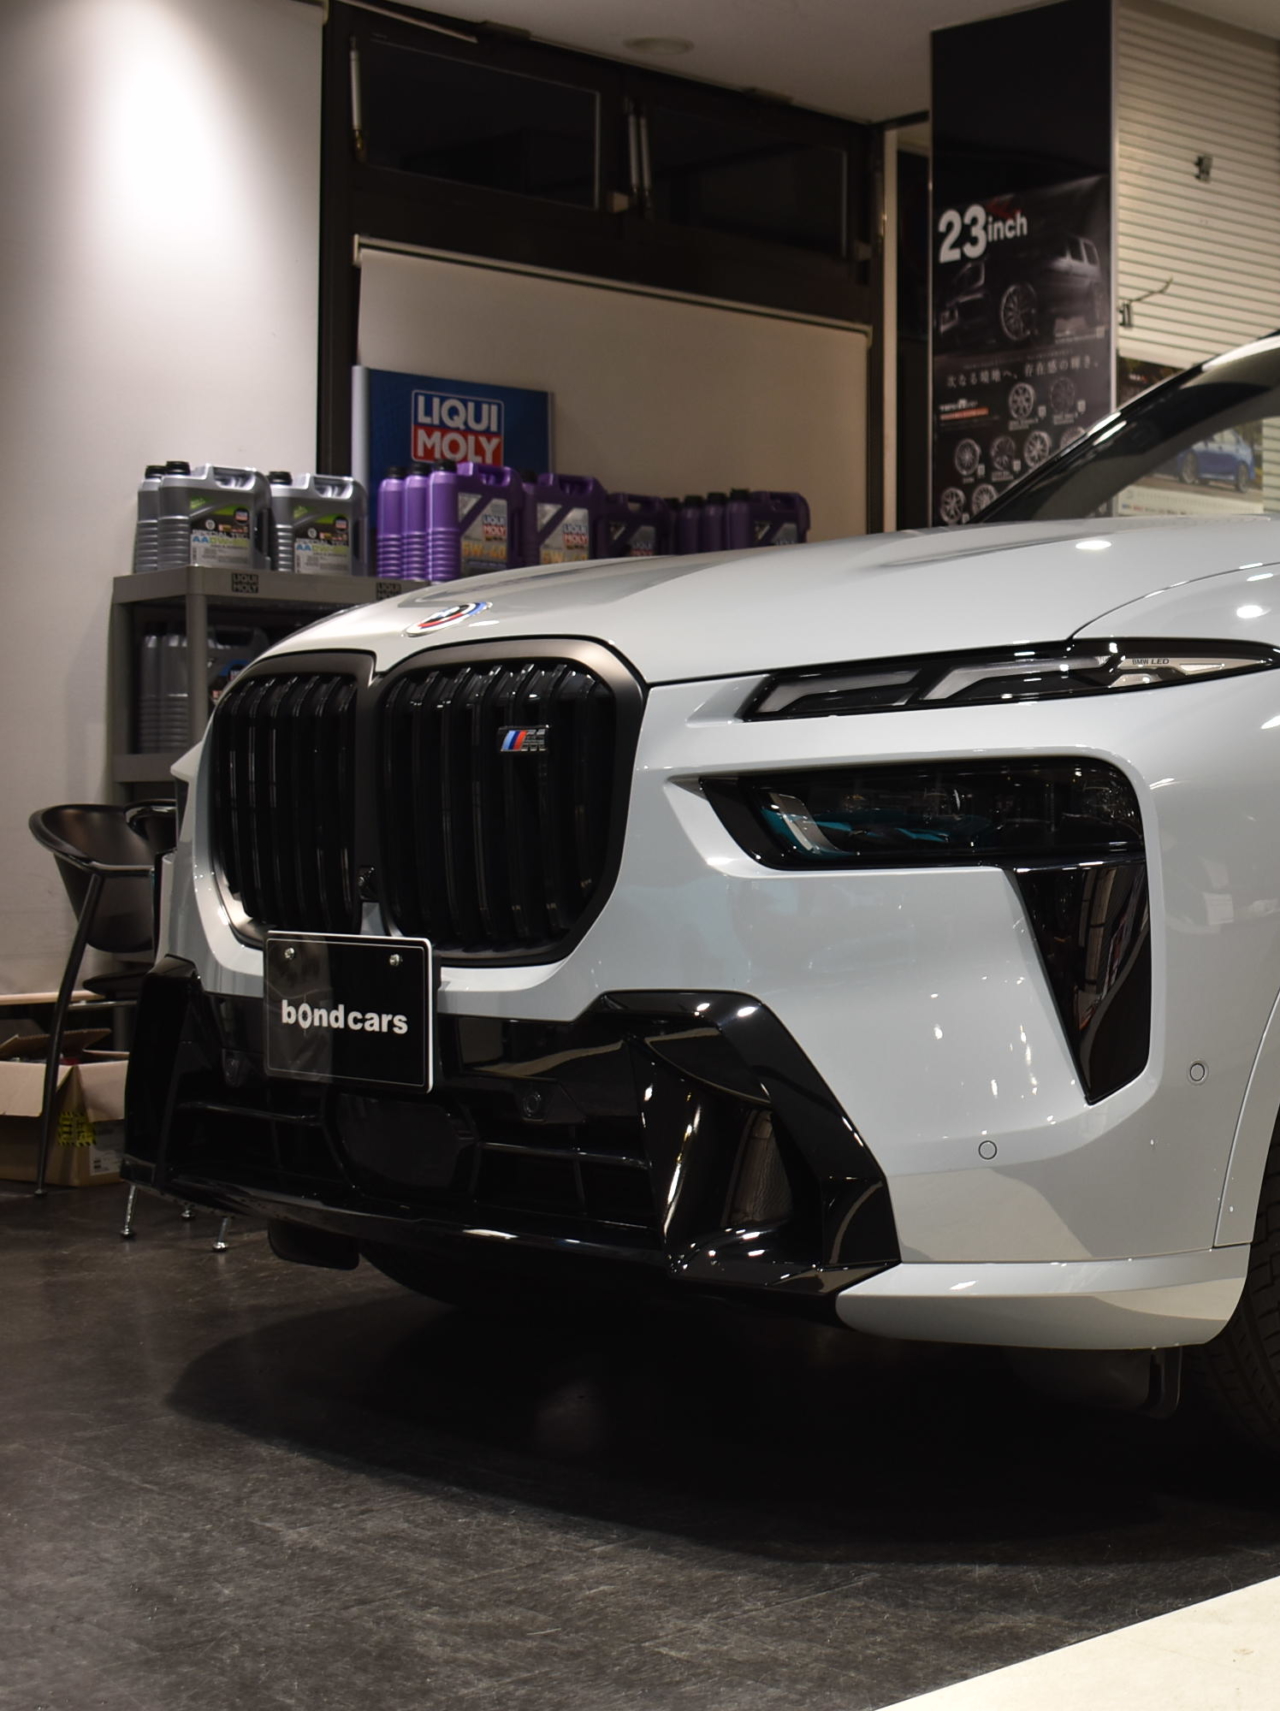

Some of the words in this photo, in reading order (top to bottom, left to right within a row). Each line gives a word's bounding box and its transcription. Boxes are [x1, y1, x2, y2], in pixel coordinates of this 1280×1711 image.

[938, 204, 987, 263] 23
[987, 211, 1027, 242] inch
[417, 395, 498, 432] LIQUI
[417, 429, 501, 466] MOLY
